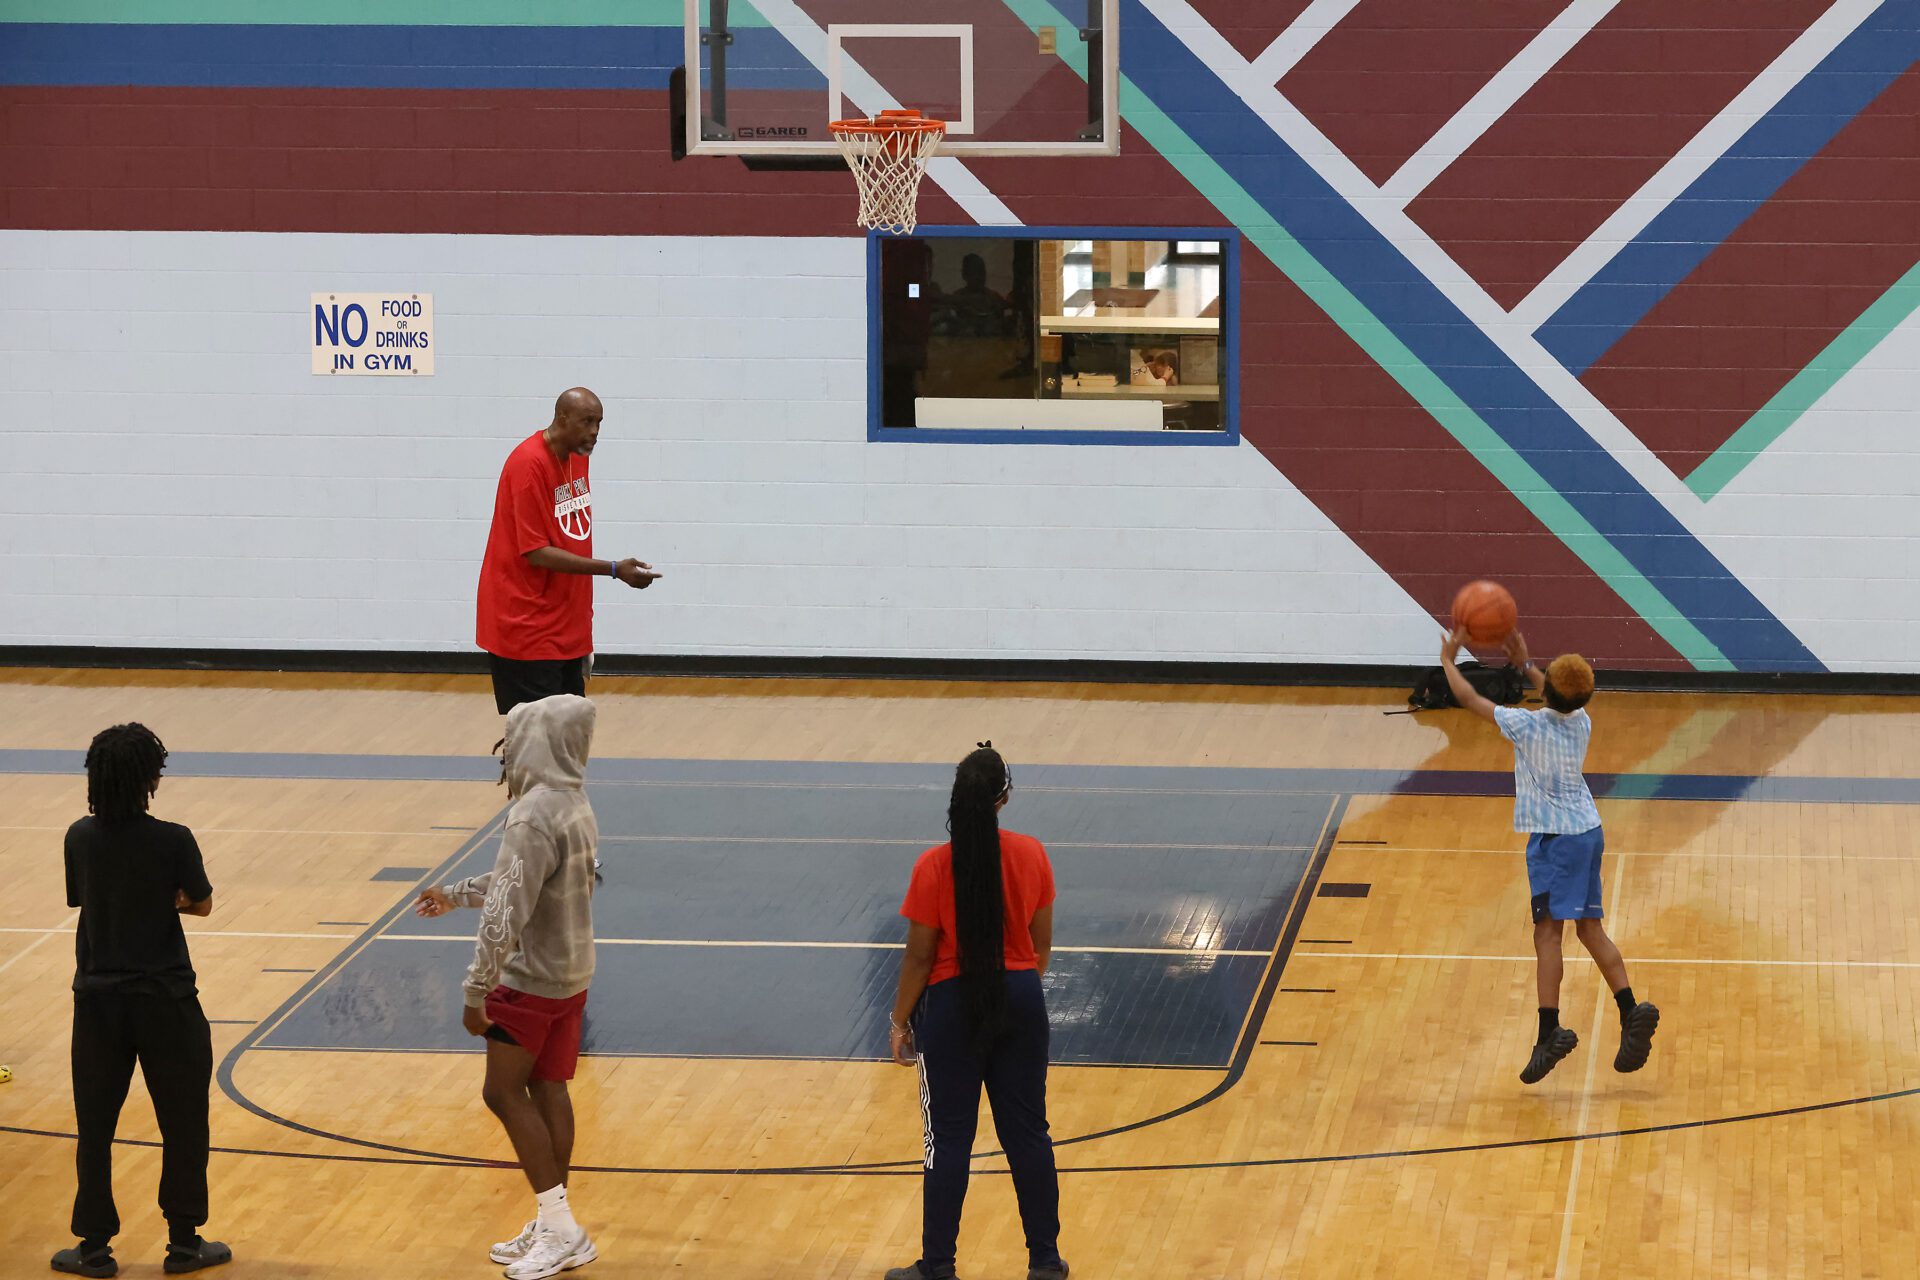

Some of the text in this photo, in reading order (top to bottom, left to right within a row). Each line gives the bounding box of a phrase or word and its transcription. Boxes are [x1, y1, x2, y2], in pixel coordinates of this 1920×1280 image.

[756, 127, 807, 136] GARED
[381, 300, 422, 317] FOOD
[315, 303, 369, 348] NO
[396, 320, 408, 330] OR
[375, 331, 429, 348] DRINKS
[334, 354, 412, 370] IN GYM
